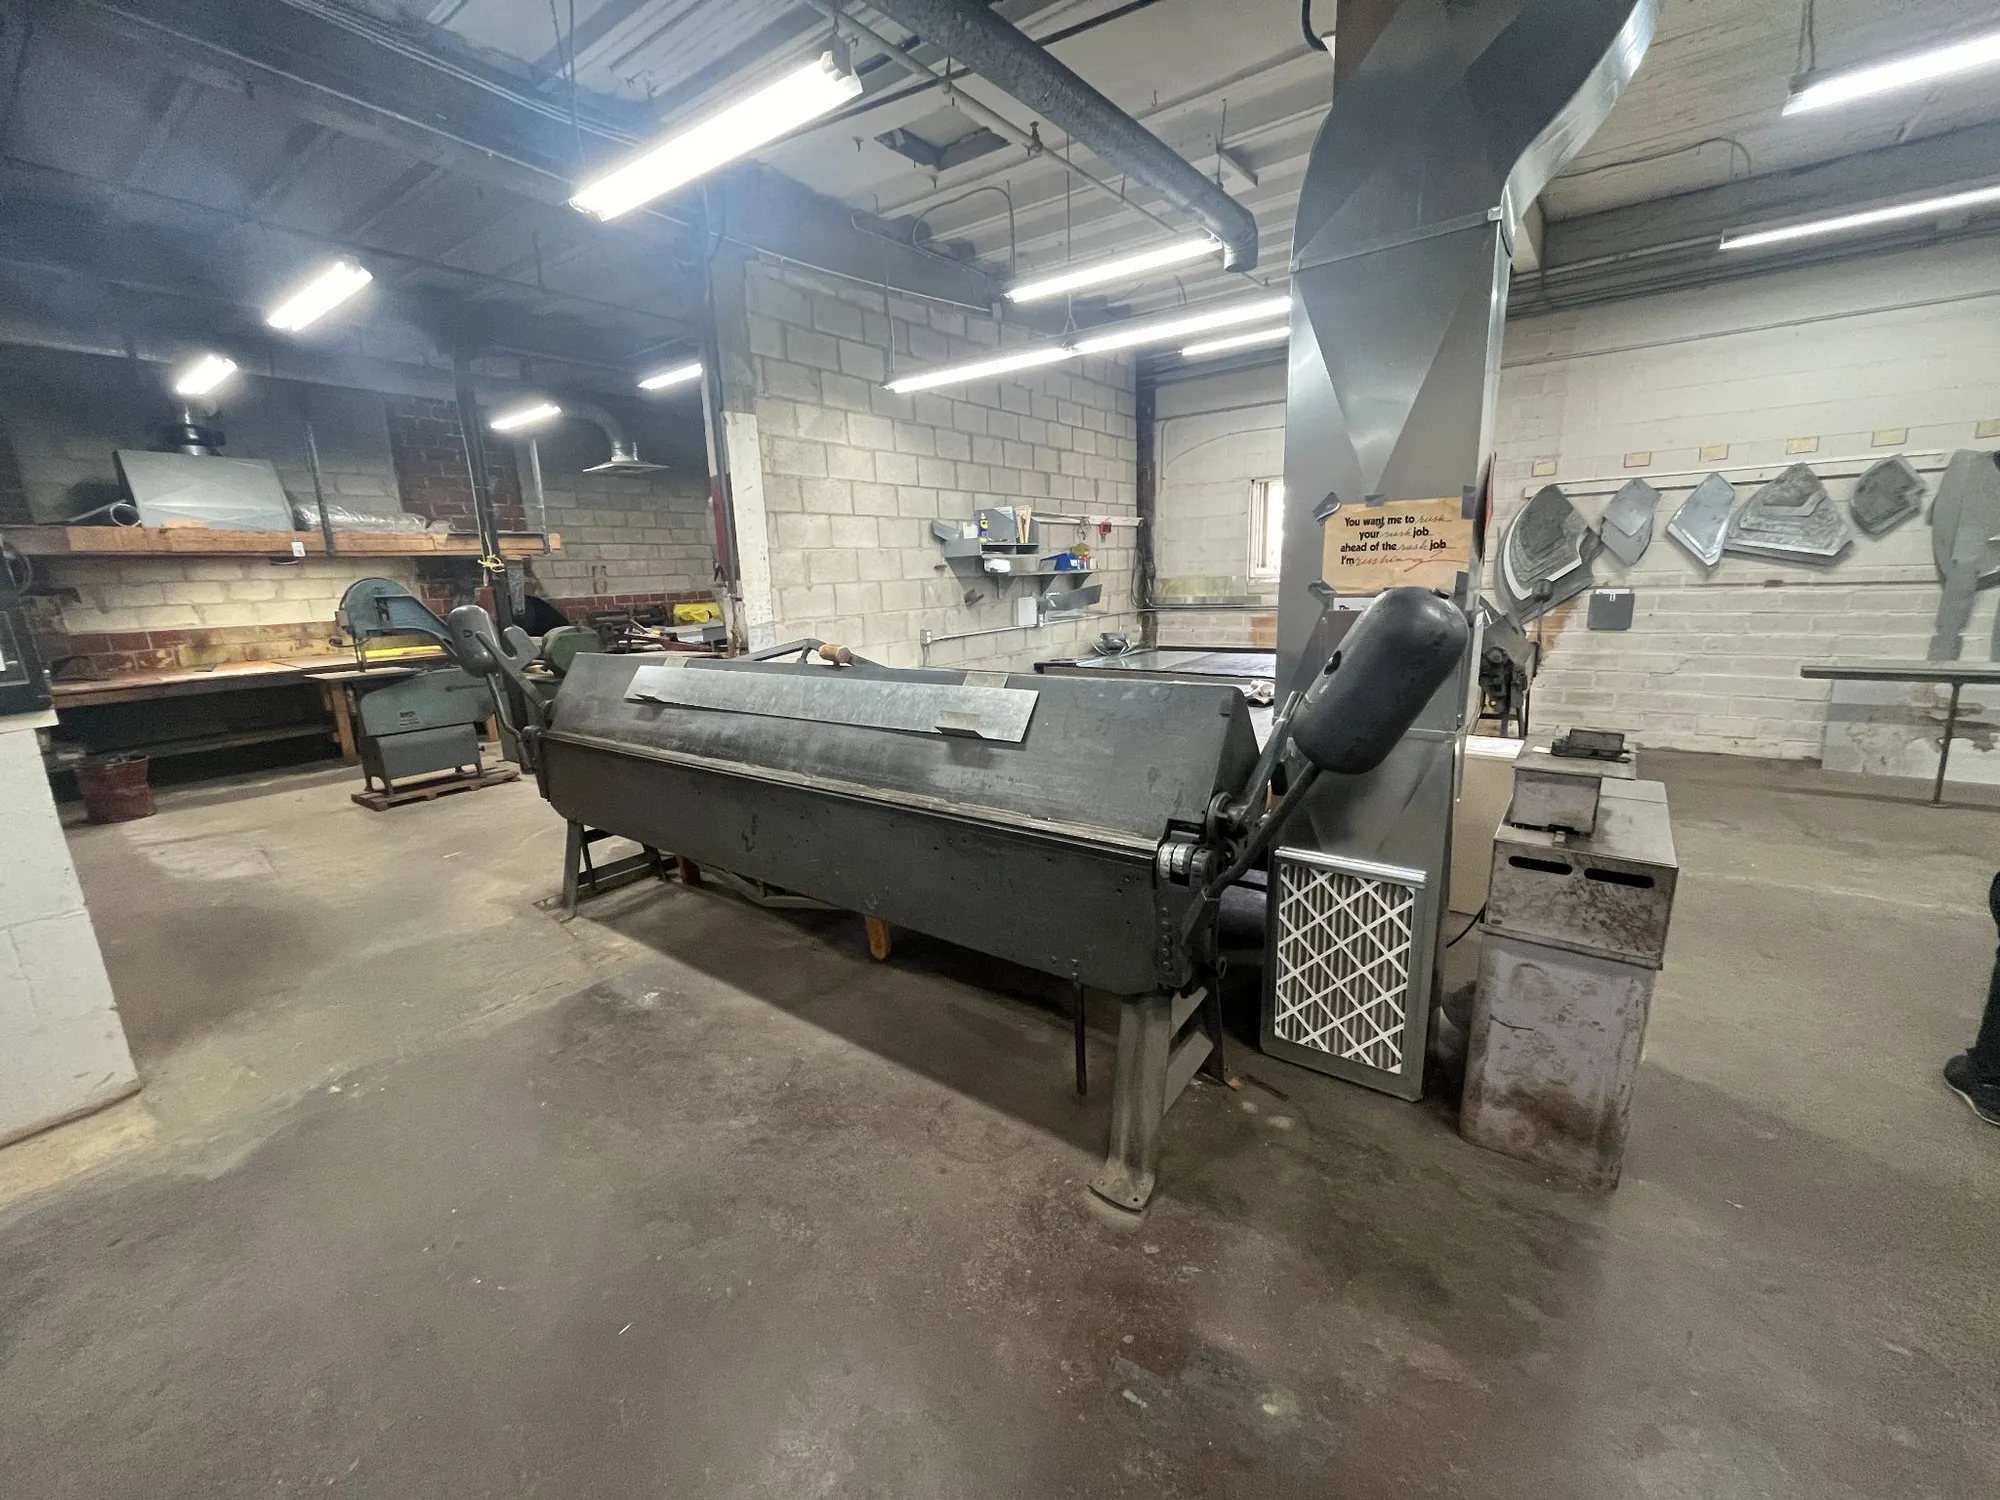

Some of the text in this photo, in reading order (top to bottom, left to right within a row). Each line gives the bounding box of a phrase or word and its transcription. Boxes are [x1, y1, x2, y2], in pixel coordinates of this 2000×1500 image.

[1344, 517, 1360, 527] You
[1362, 517, 1385, 529] want
[1387, 516, 1402, 525] me
[1405, 515, 1415, 524] to
[1359, 531, 1380, 541] your
[1413, 526, 1429, 538] job
[1340, 542, 1367, 552] ahead
[1369, 541, 1380, 551] of
[1382, 541, 1397, 551] the
[1429, 539, 1447, 551] job
[1341, 555, 1355, 565] I'm
